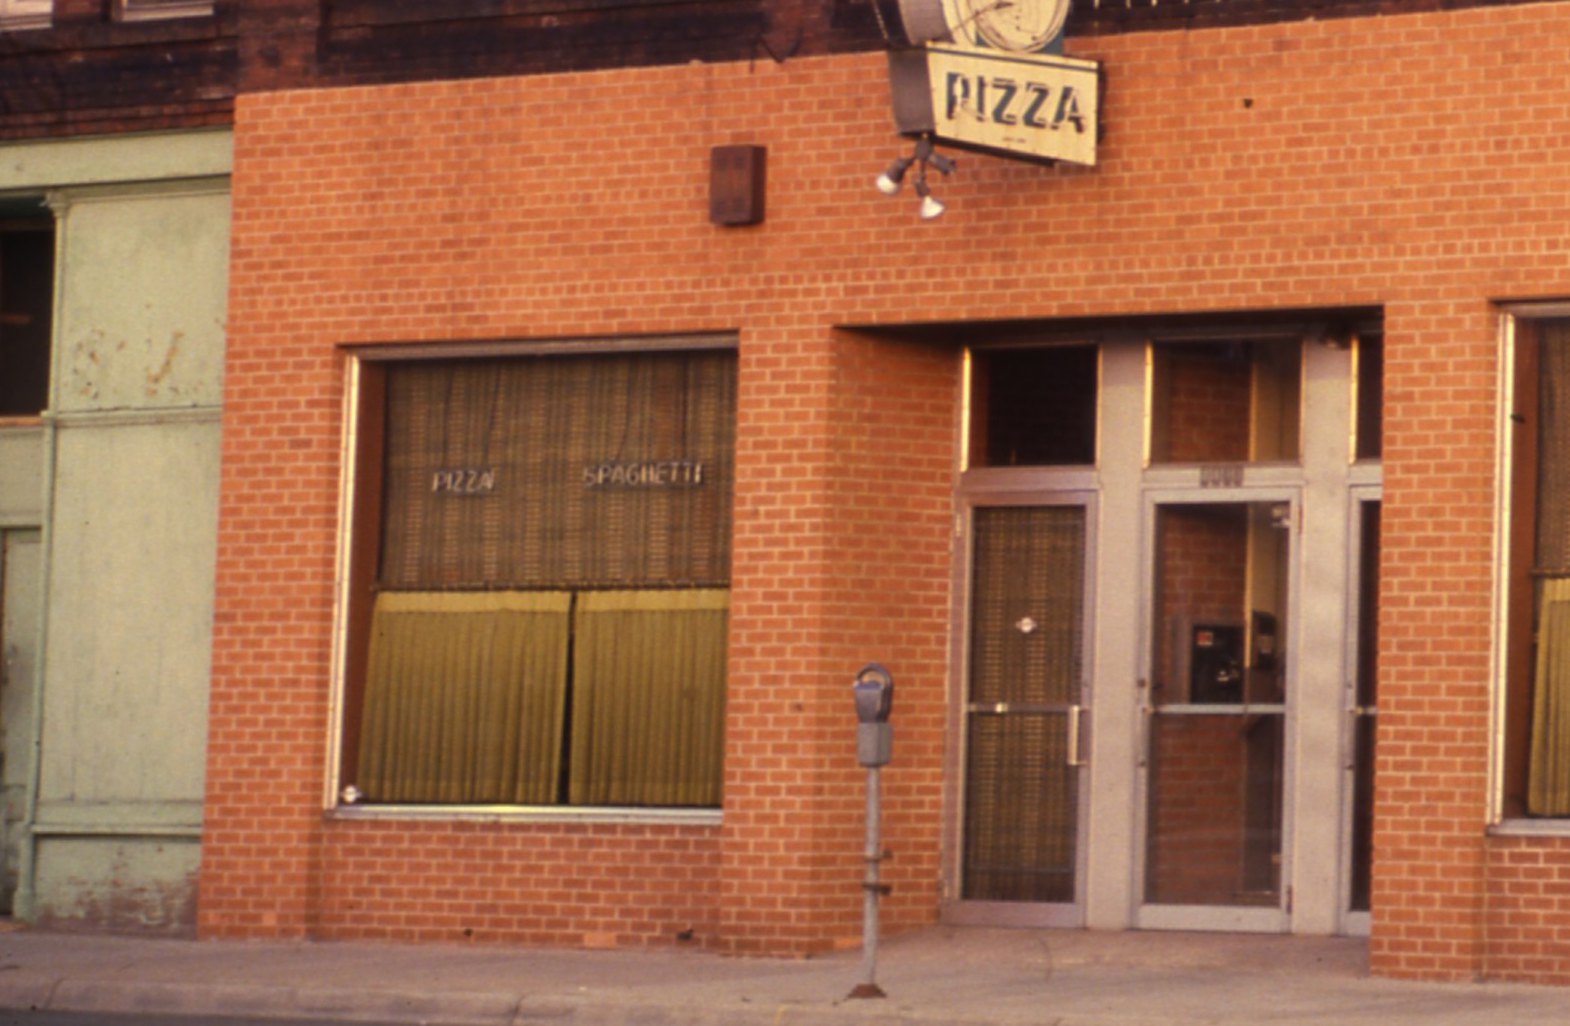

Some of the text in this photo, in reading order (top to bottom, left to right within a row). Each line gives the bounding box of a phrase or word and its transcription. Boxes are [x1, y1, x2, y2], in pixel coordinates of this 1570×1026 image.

[945, 71, 1085, 135] PIZZA
[432, 460, 703, 493] PIZZA SPAGHETTI
